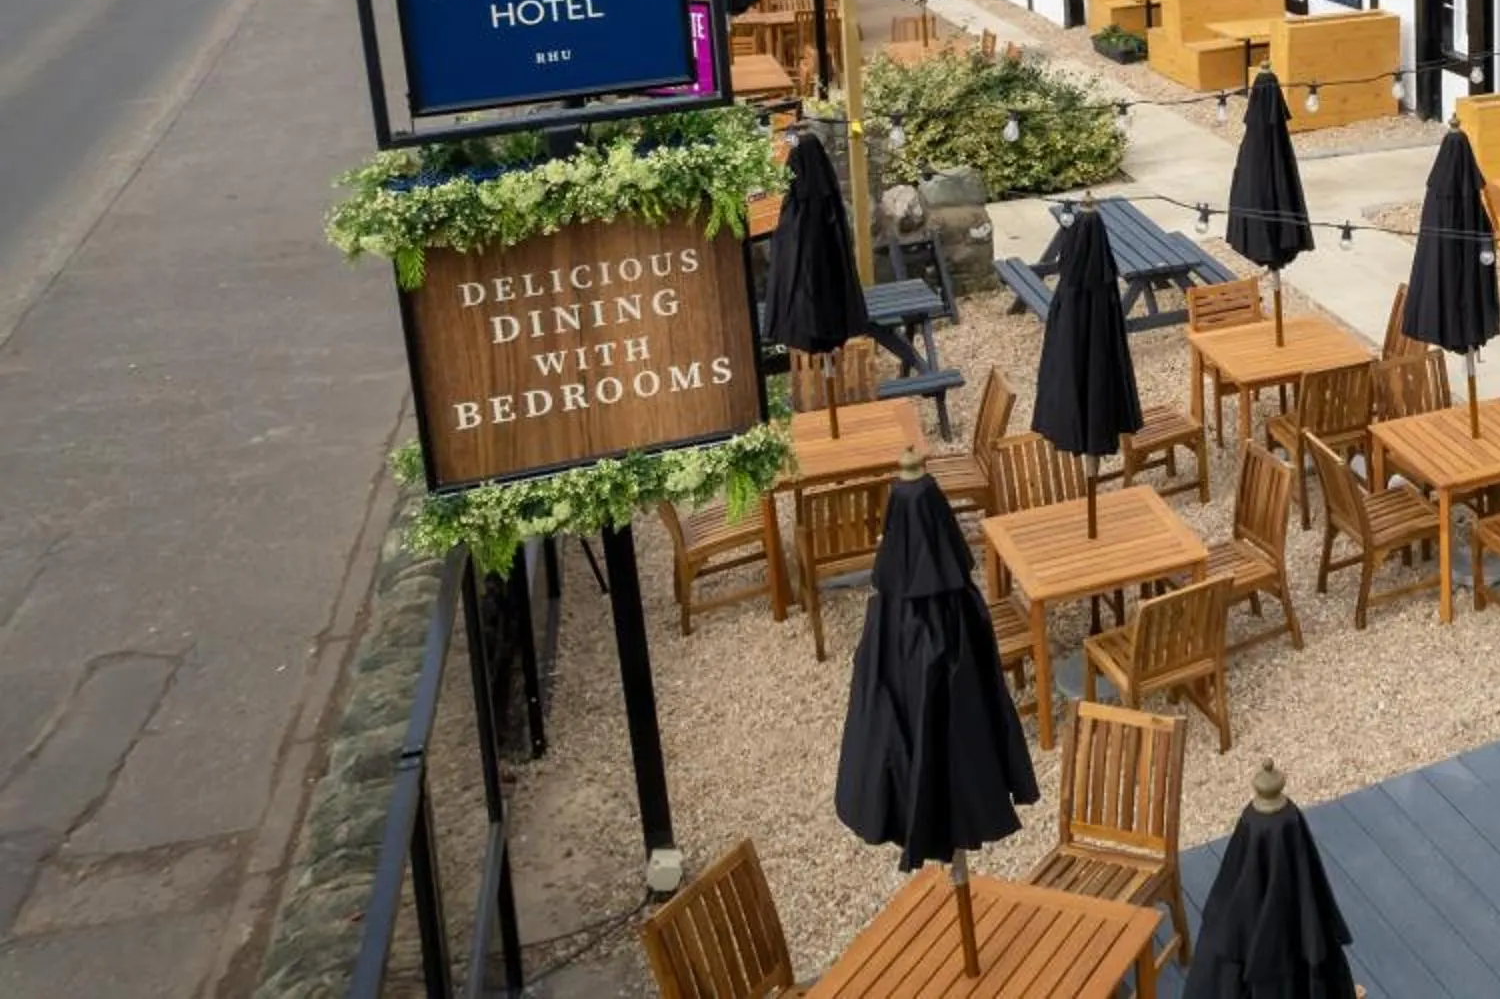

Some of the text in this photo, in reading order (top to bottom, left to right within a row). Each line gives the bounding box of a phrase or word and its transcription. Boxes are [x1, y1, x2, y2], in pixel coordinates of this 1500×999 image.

[535, 49, 573, 65] RHU
[458, 248, 700, 308] DELICIOUS
[489, 288, 680, 344] DINING
[531, 335, 651, 377] WITH
[453, 357, 733, 431] BEDROOMS
